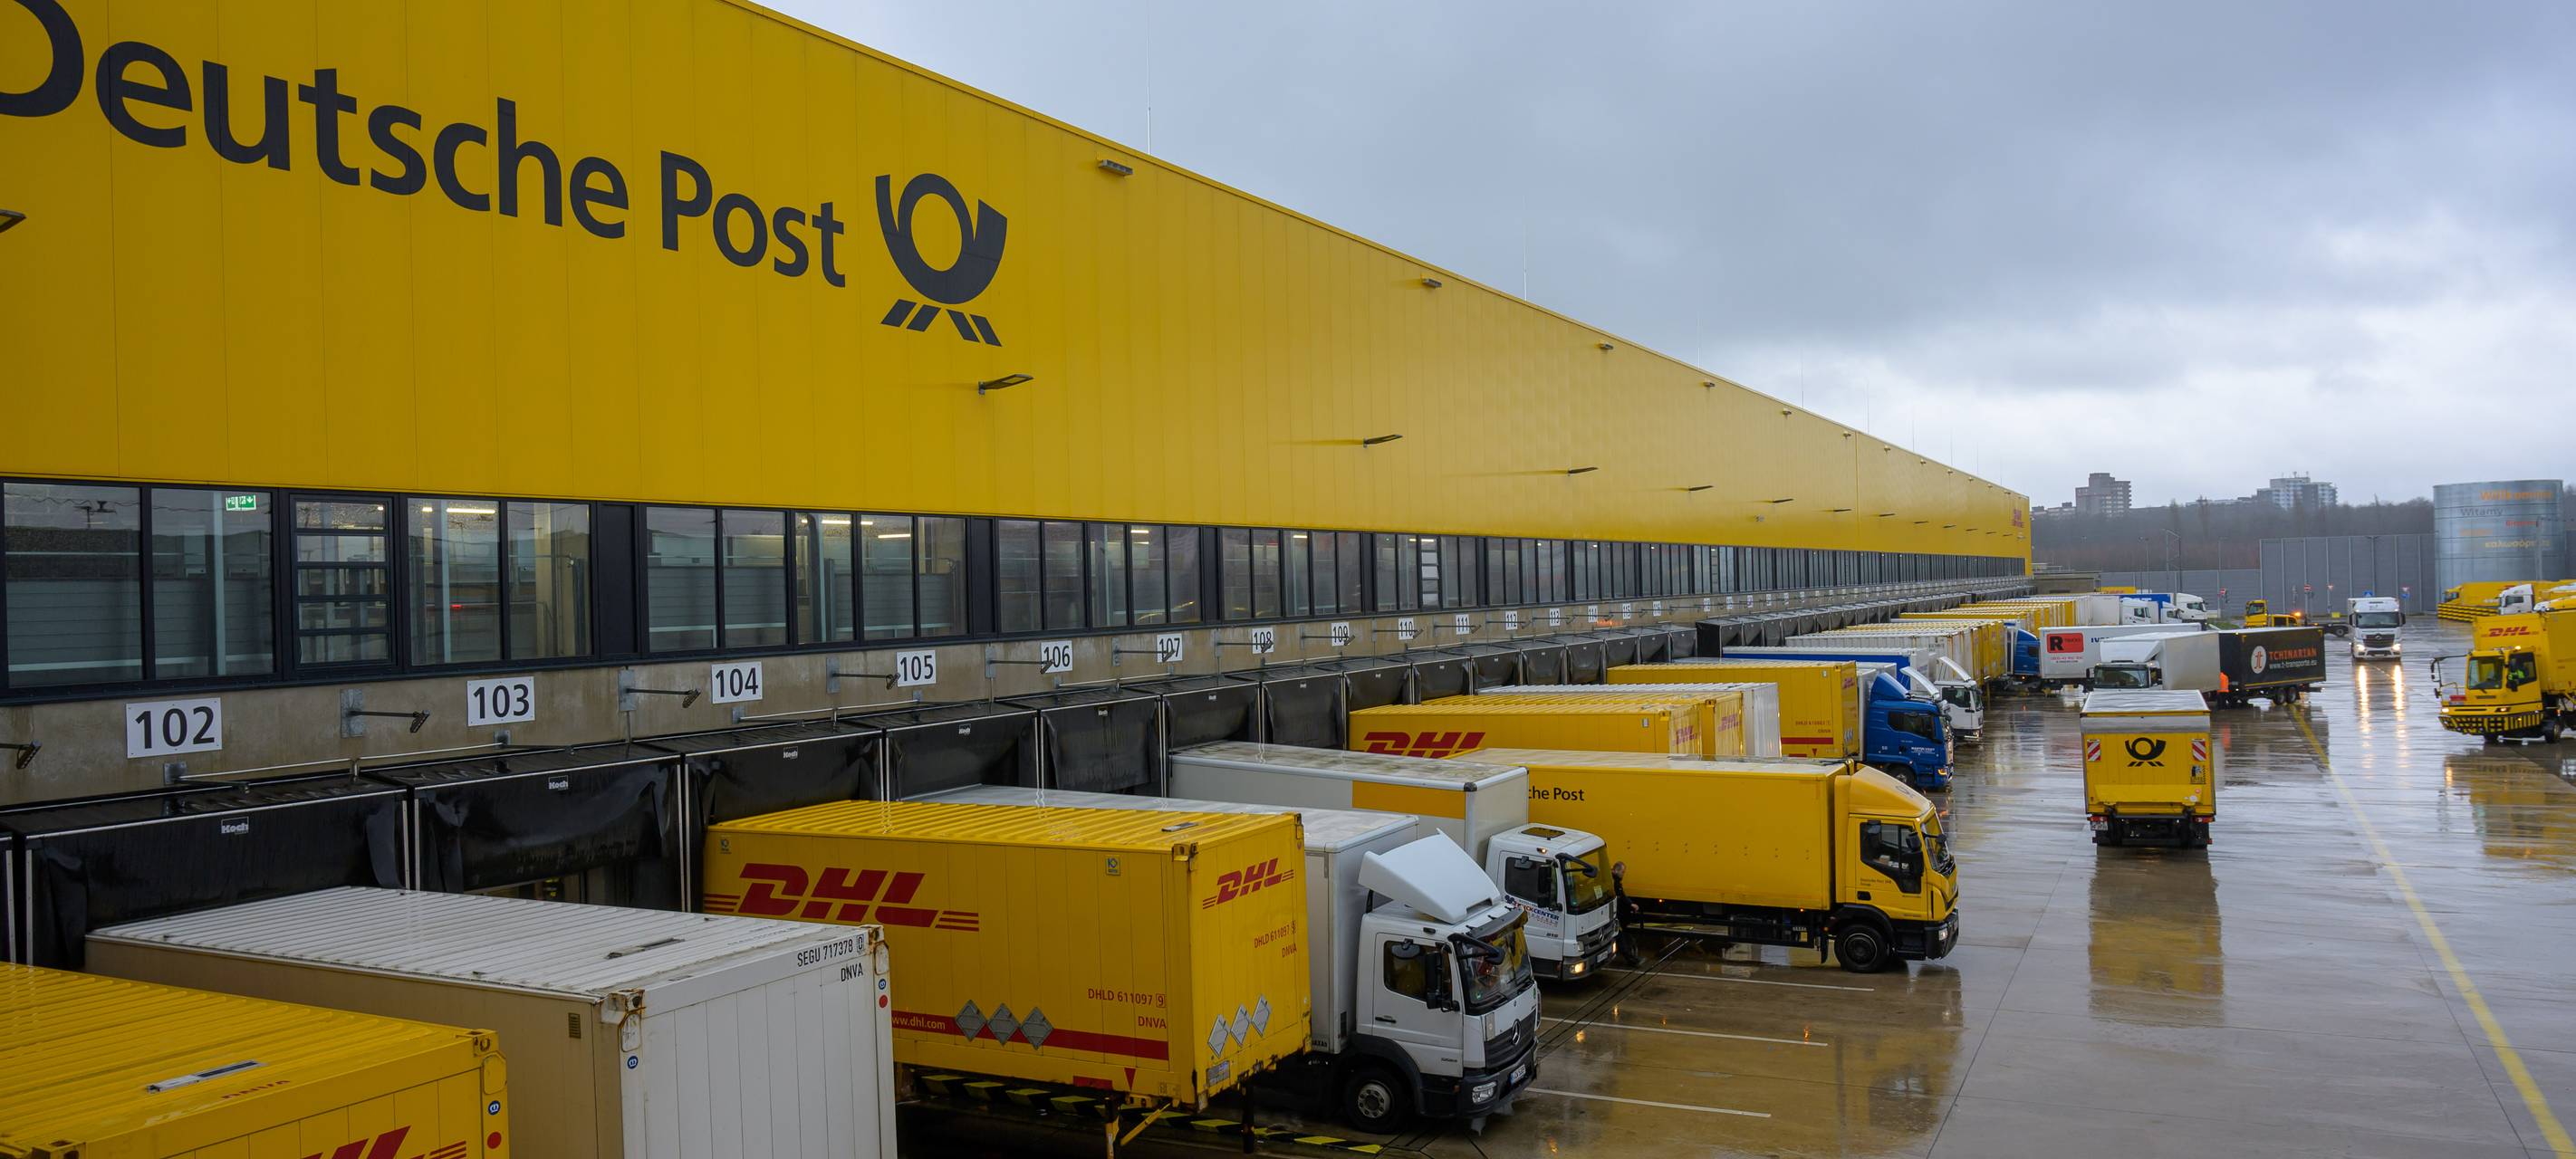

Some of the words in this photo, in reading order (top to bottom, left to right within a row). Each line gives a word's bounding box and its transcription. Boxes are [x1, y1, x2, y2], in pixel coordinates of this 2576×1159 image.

[661, 150, 845, 287] Post
[1399, 620, 1414, 637] 110
[1456, 617, 1469, 633] 111
[2489, 626, 2530, 637] DHL
[1254, 631, 1272, 650] 108
[1332, 626, 1349, 644] 109
[2050, 636, 2063, 651] R
[1043, 645, 1071, 669] 106
[1158, 637, 1180, 658] 107
[900, 655, 934, 683] 105
[715, 667, 759, 699] 104
[474, 684, 530, 721] 103
[135, 706, 216, 750] 102
[549, 780, 568, 790] Koch
[1528, 785, 1550, 800] he
[1553, 787, 1584, 800] Post
[222, 822, 249, 834] Koch
[1216, 857, 1283, 905] DHL
[738, 863, 938, 927] DHL
[1254, 934, 1269, 948] DHLD
[1271, 924, 1290, 942] 611097
[797, 947, 821, 967] SEGU
[823, 939, 853, 960] 717378
[841, 963, 863, 982] DNVA
[1088, 988, 1114, 1001] DHLD
[1118, 991, 1153, 1005] 611097
[1138, 1016, 1167, 1030] DNVA
